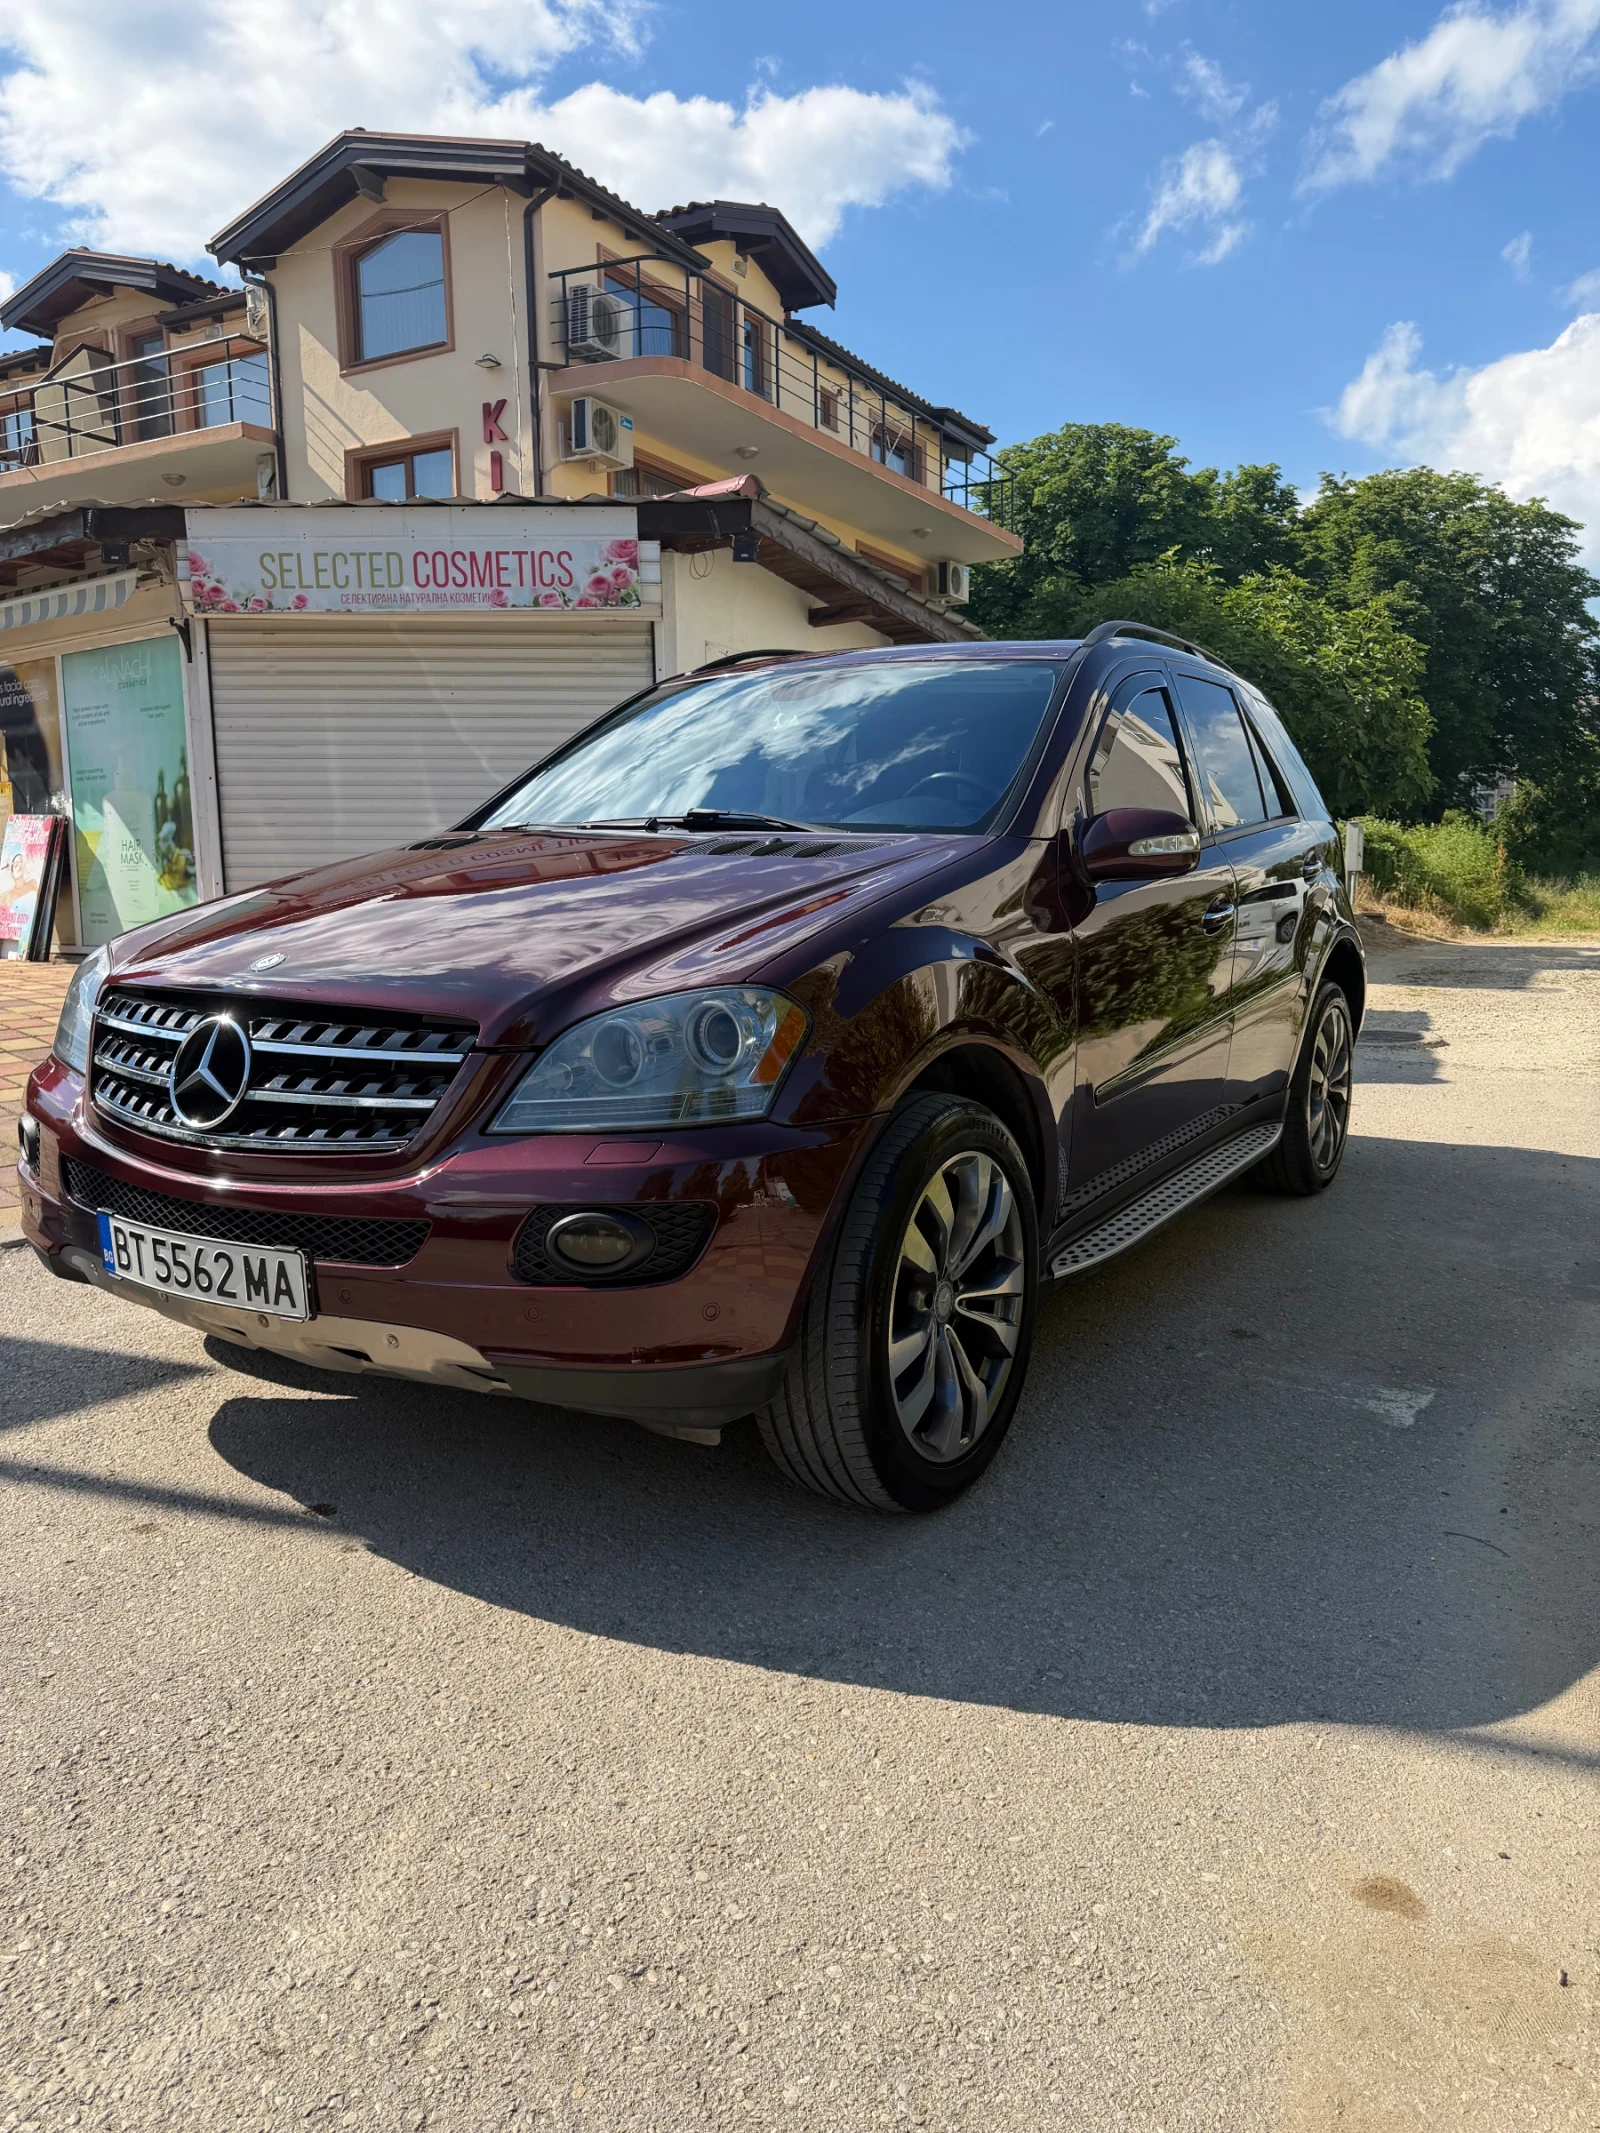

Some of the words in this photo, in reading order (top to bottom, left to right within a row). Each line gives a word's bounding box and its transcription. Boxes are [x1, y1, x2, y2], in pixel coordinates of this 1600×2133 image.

[259, 551, 403, 590] SELECTED
[413, 549, 575, 588] COSMETICS
[341, 593, 398, 605] СЕЛЕКТИРАНА
[399, 592, 449, 605] НАТУРАЛНА
[118, 679, 147, 690] COSMETICS
[121, 839, 142, 852] HAIR
[120, 852, 145, 865] MASK
[103, 1249, 114, 1264] BG
[113, 1225, 145, 1277] BT
[152, 1239, 237, 1299] 5562
[243, 1254, 297, 1309] MA
